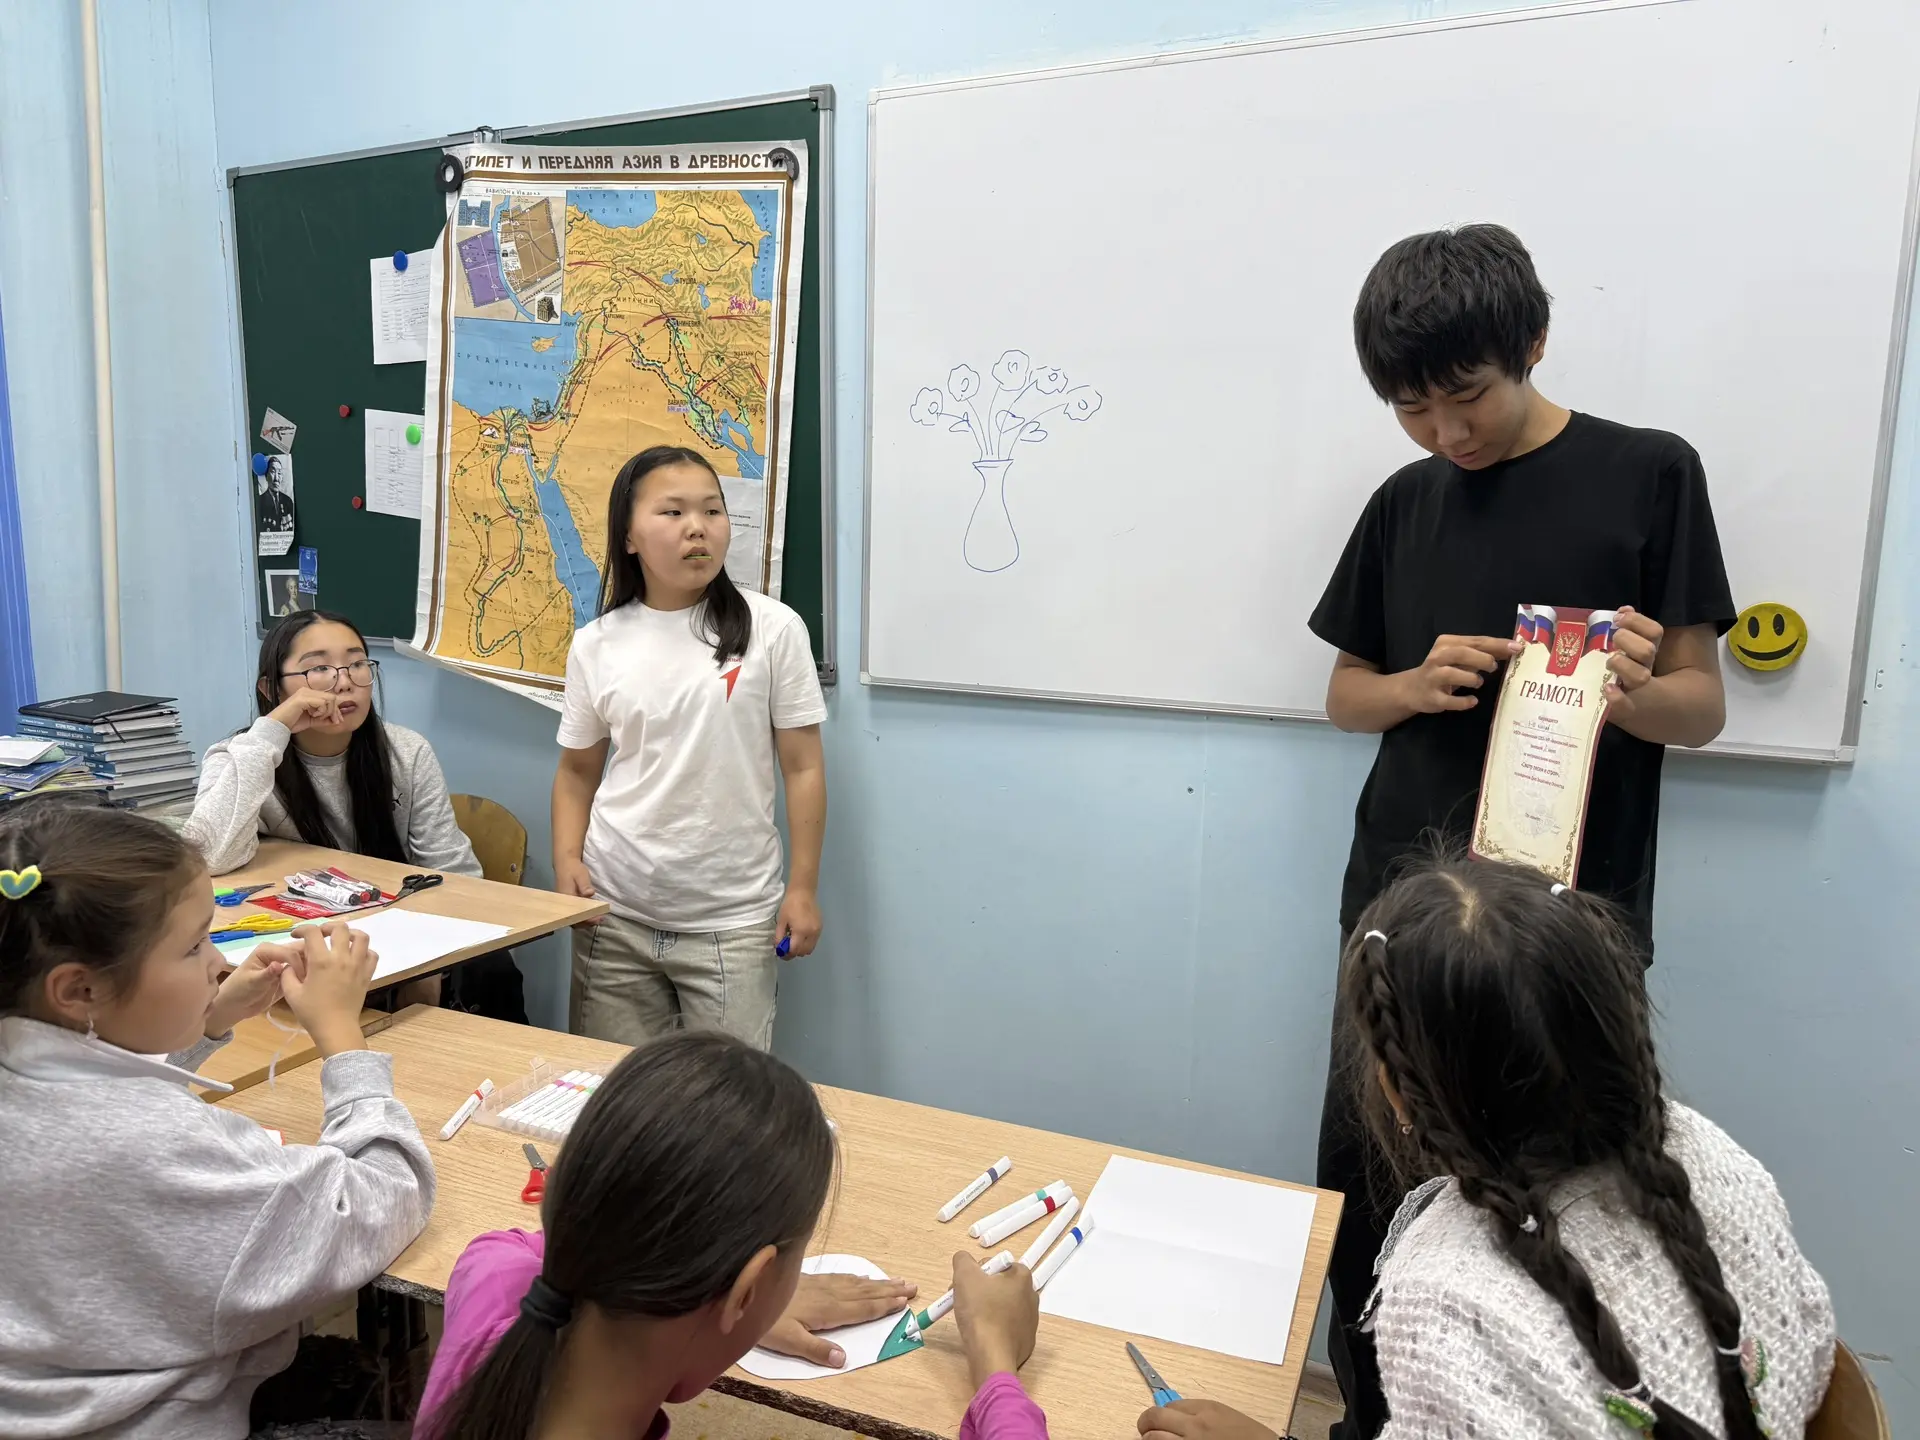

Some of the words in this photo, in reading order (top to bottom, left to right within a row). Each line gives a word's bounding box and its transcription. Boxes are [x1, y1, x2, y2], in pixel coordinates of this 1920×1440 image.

[464, 155, 514, 169] ЕГИПЕТ
[521, 155, 532, 169] И
[538, 155, 614, 169] ПЕРЕДНЯЯ
[622, 154, 662, 169] АЗИЯ
[670, 154, 680, 169] В
[616, 296, 654, 304] МИТАННИ
[457, 352, 556, 372] СРЕДИЗЕМНОЕ
[488, 380, 522, 390] МОРЕ
[1519, 679, 1584, 708] ГРАМОТА
